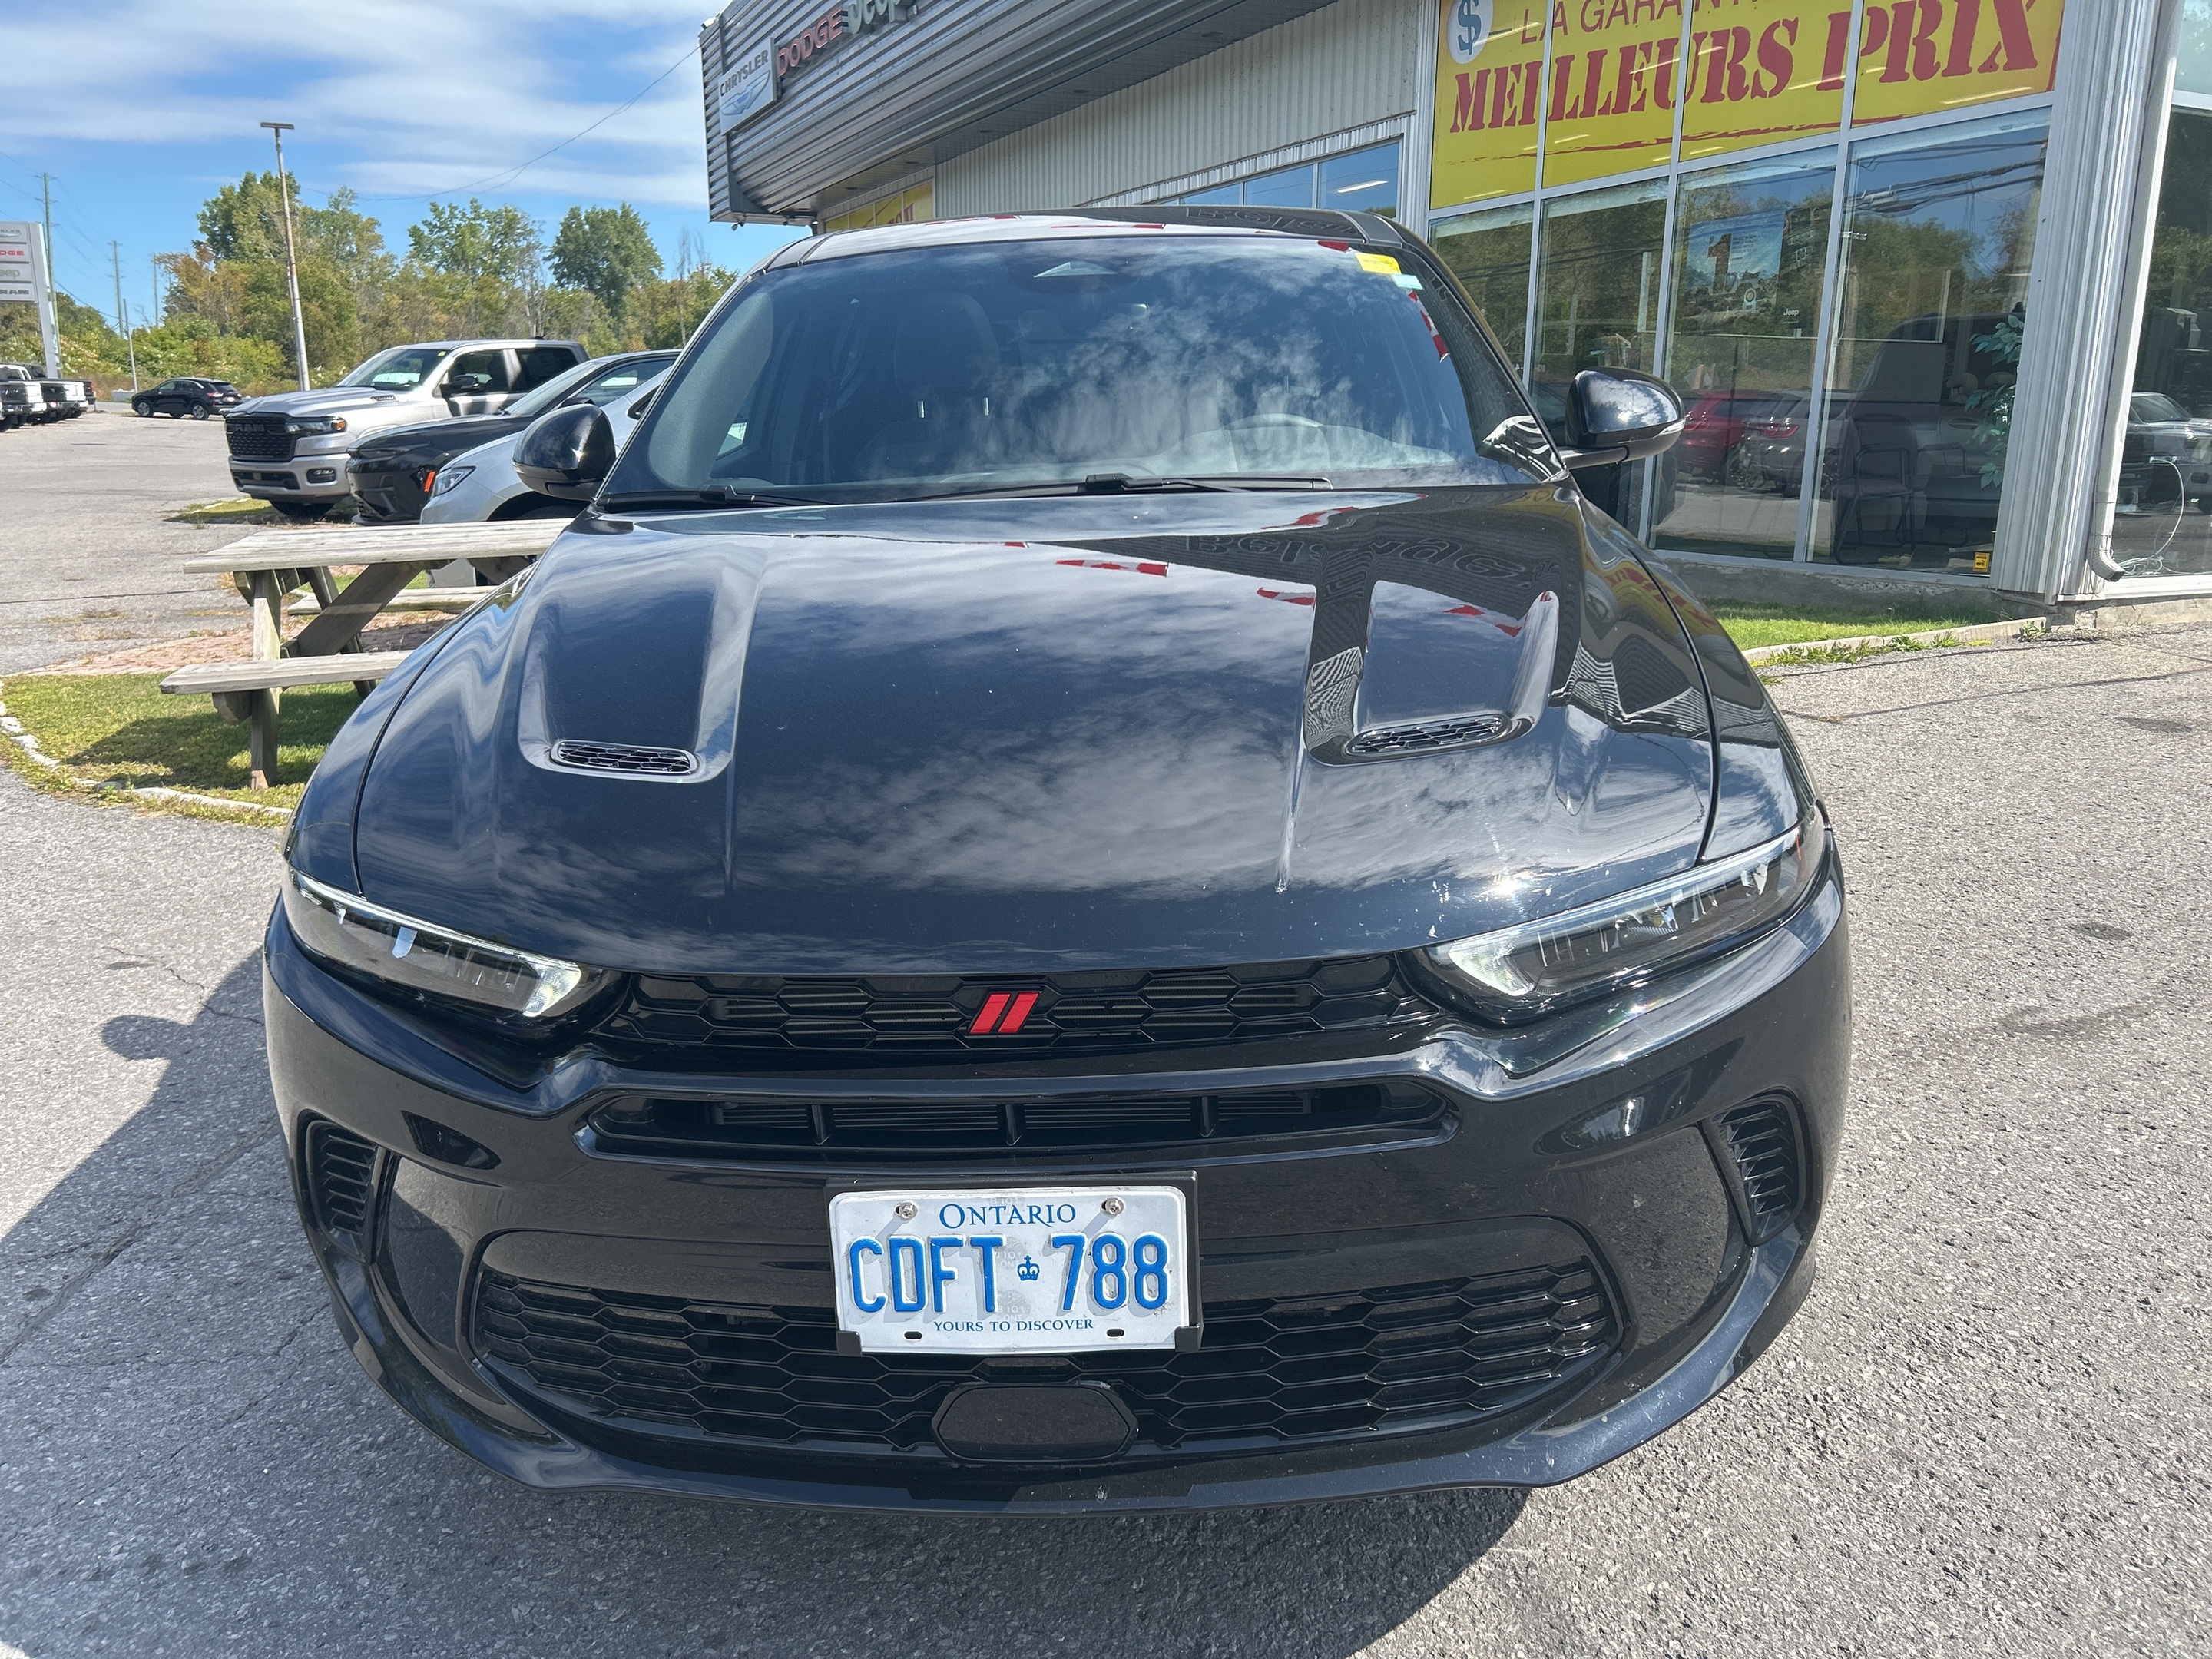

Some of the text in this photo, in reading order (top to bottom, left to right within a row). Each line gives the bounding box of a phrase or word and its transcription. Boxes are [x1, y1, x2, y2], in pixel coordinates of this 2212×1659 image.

[776, 7, 843, 77] DODGE
[1521, 0, 1568, 45] LA
[720, 49, 769, 98] CHRYSLER
[1449, 0, 2038, 134] MEILLEURS PRIX
[1783, 308, 1800, 316] Jeep
[234, 423, 265, 432] RAM
[939, 1203, 1077, 1230] ONTARIO
[849, 1231, 1171, 1313] CDFT 788
[933, 1317, 1094, 1332] YOURS TO DISCOVER
